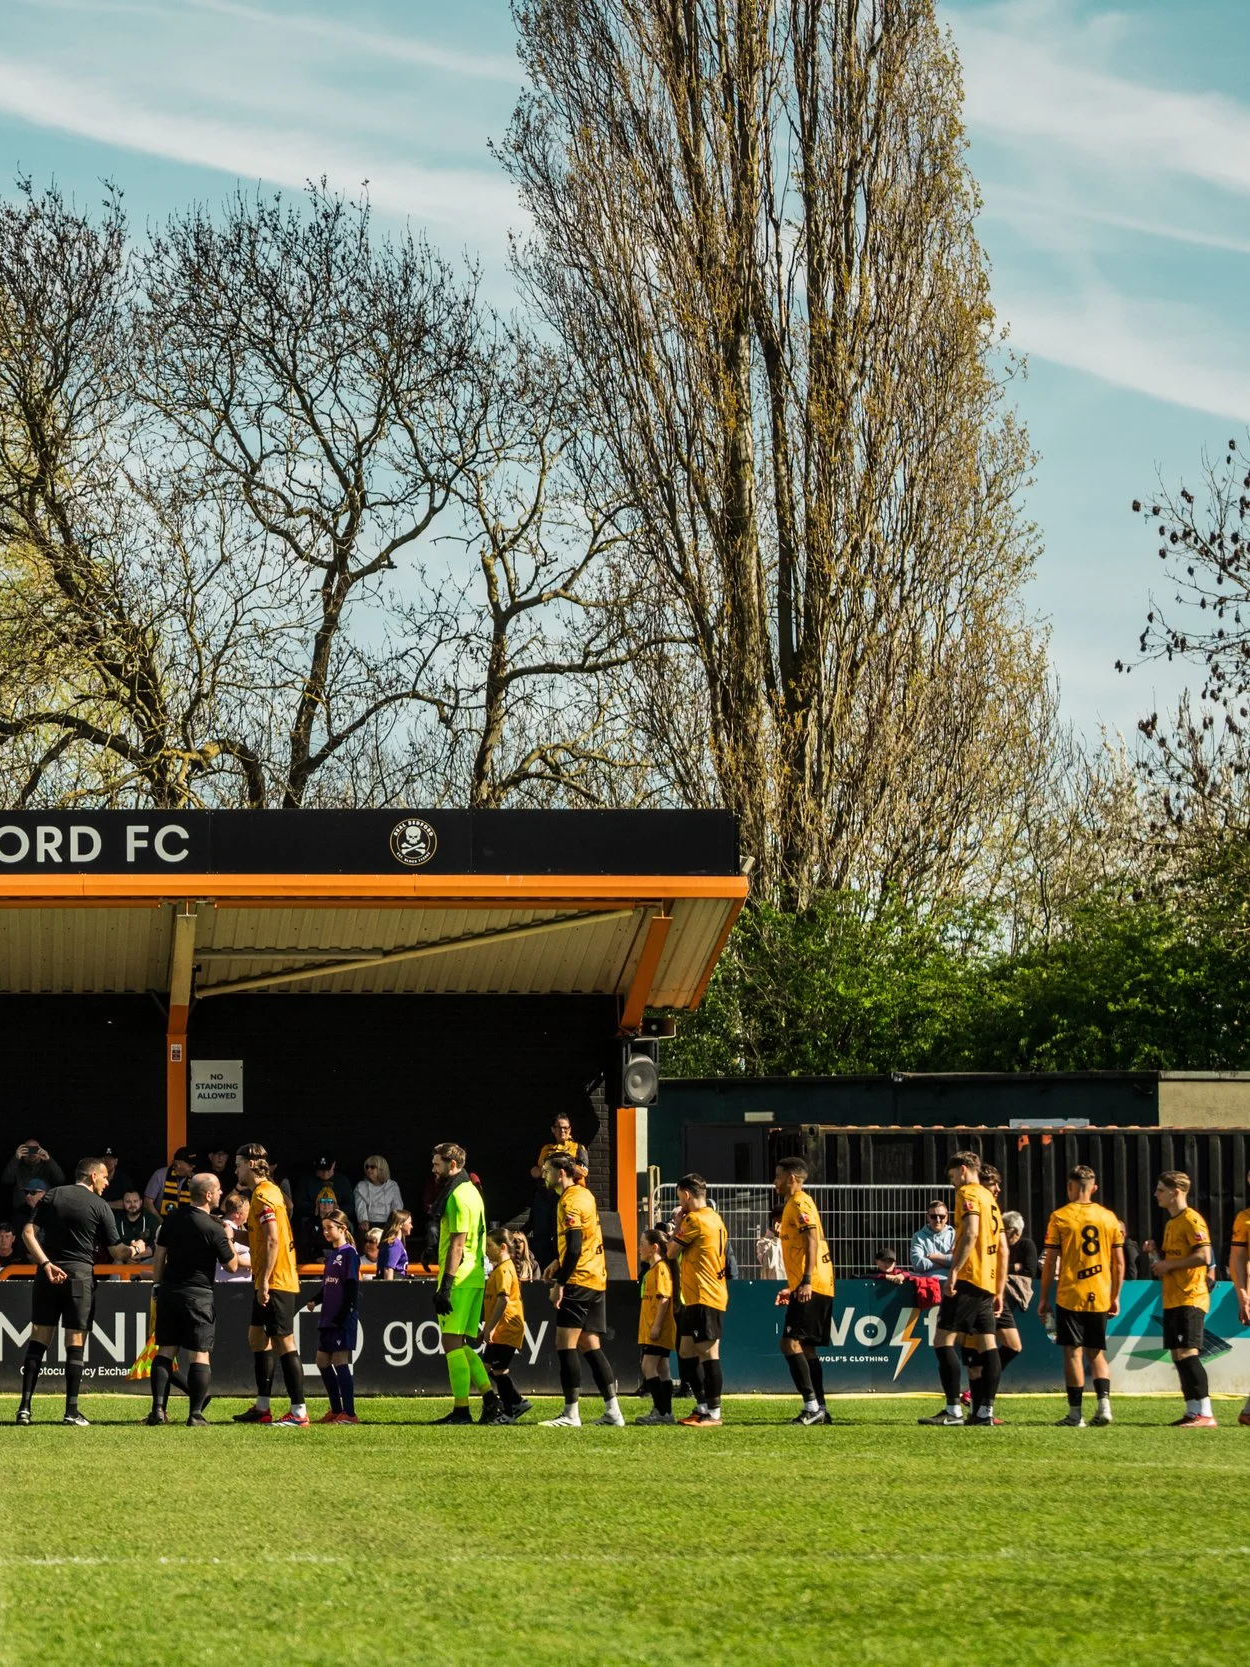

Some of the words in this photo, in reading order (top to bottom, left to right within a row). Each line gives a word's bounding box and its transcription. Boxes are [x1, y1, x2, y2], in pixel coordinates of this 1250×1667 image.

[394, 823, 406, 836] REAL
[408, 820, 434, 836] BEDFORD
[126, 825, 190, 864] FC
[210, 1073, 224, 1081] NO
[196, 1092, 237, 1100] ALLOWED
[990, 1204, 999, 1236] 5
[1081, 1225, 1100, 1257] 8
[818, 1355, 848, 1363] WOLF'S
[849, 1355, 889, 1363] CLOTHING
